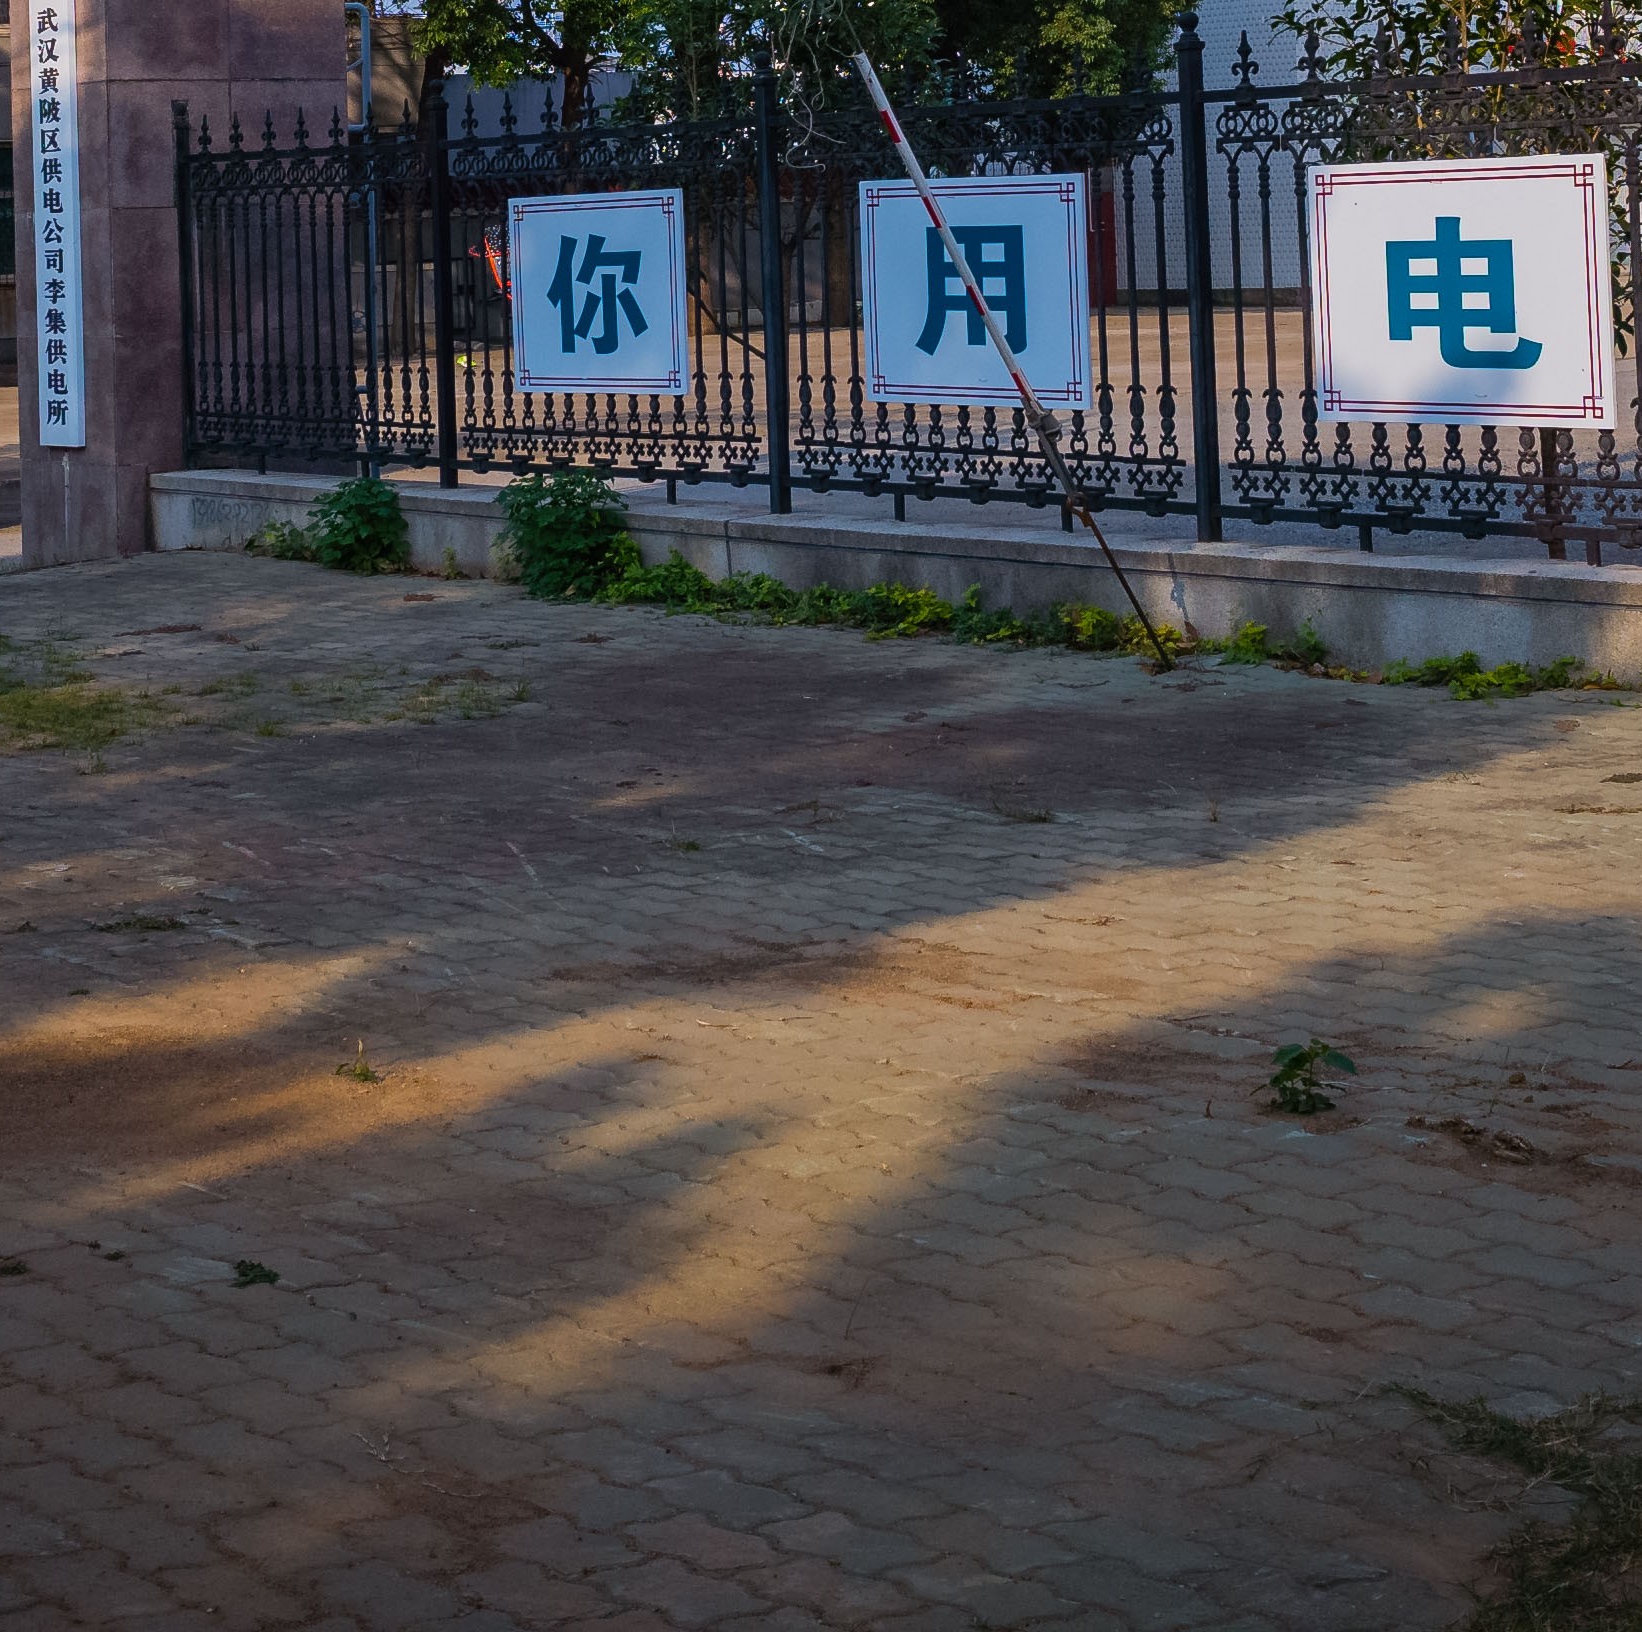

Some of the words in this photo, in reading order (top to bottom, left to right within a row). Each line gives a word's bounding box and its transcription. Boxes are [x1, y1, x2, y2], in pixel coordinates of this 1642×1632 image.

[36, 8, 69, 426] 武汉黄陂区供电公司李集供电所
[547, 233, 650, 356] 你
[915, 224, 1029, 357] 用
[1385, 216, 1543, 369] 电
